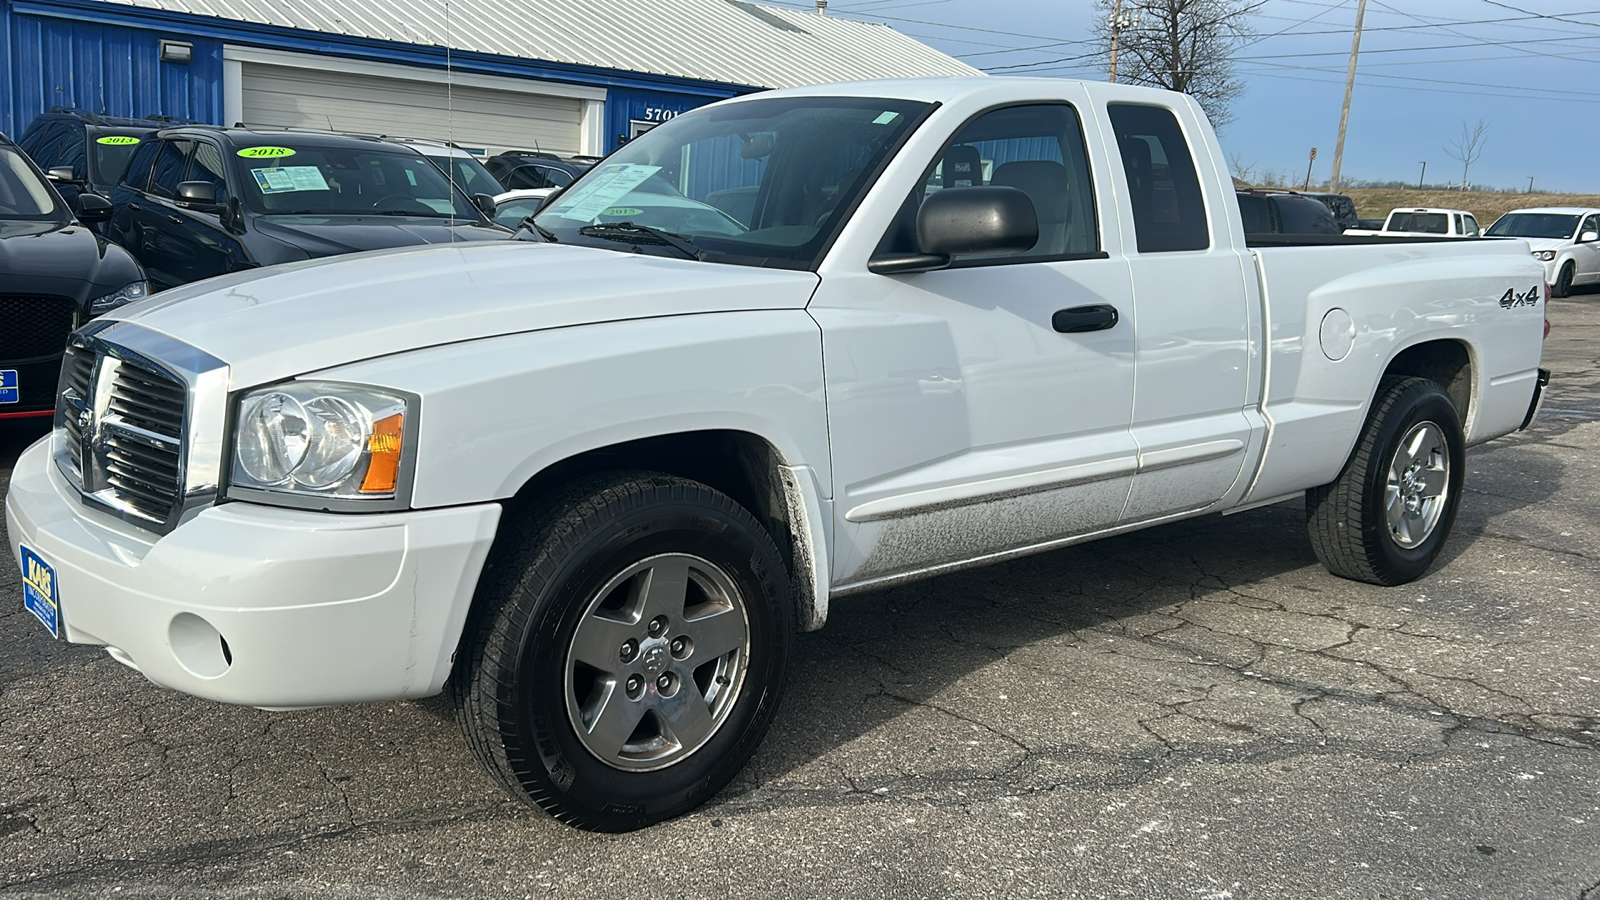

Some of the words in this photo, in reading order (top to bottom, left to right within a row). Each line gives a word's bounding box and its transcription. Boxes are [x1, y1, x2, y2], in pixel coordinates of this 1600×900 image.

[249, 148, 285, 156] 2018
[1499, 285, 1540, 309] 4x4
[28, 556, 51, 597] KARS
